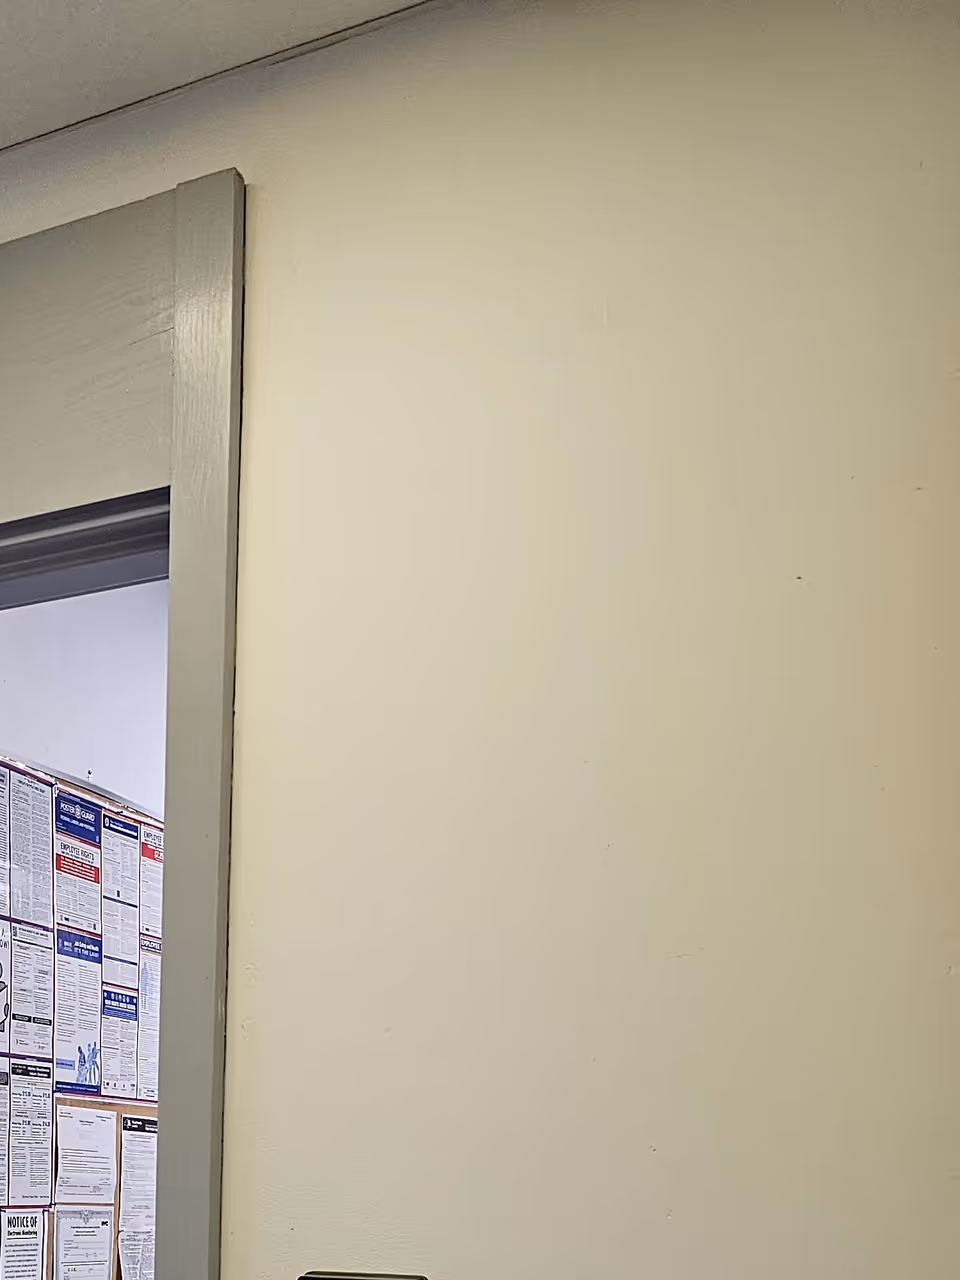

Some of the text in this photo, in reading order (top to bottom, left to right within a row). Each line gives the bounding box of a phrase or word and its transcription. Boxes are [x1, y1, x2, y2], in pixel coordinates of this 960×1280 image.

[60, 802, 76, 814] POSTER
[60, 842, 96, 861] EMPLOYEE RIGHTS
[7, 1216, 38, 1228] NOTICE OF
